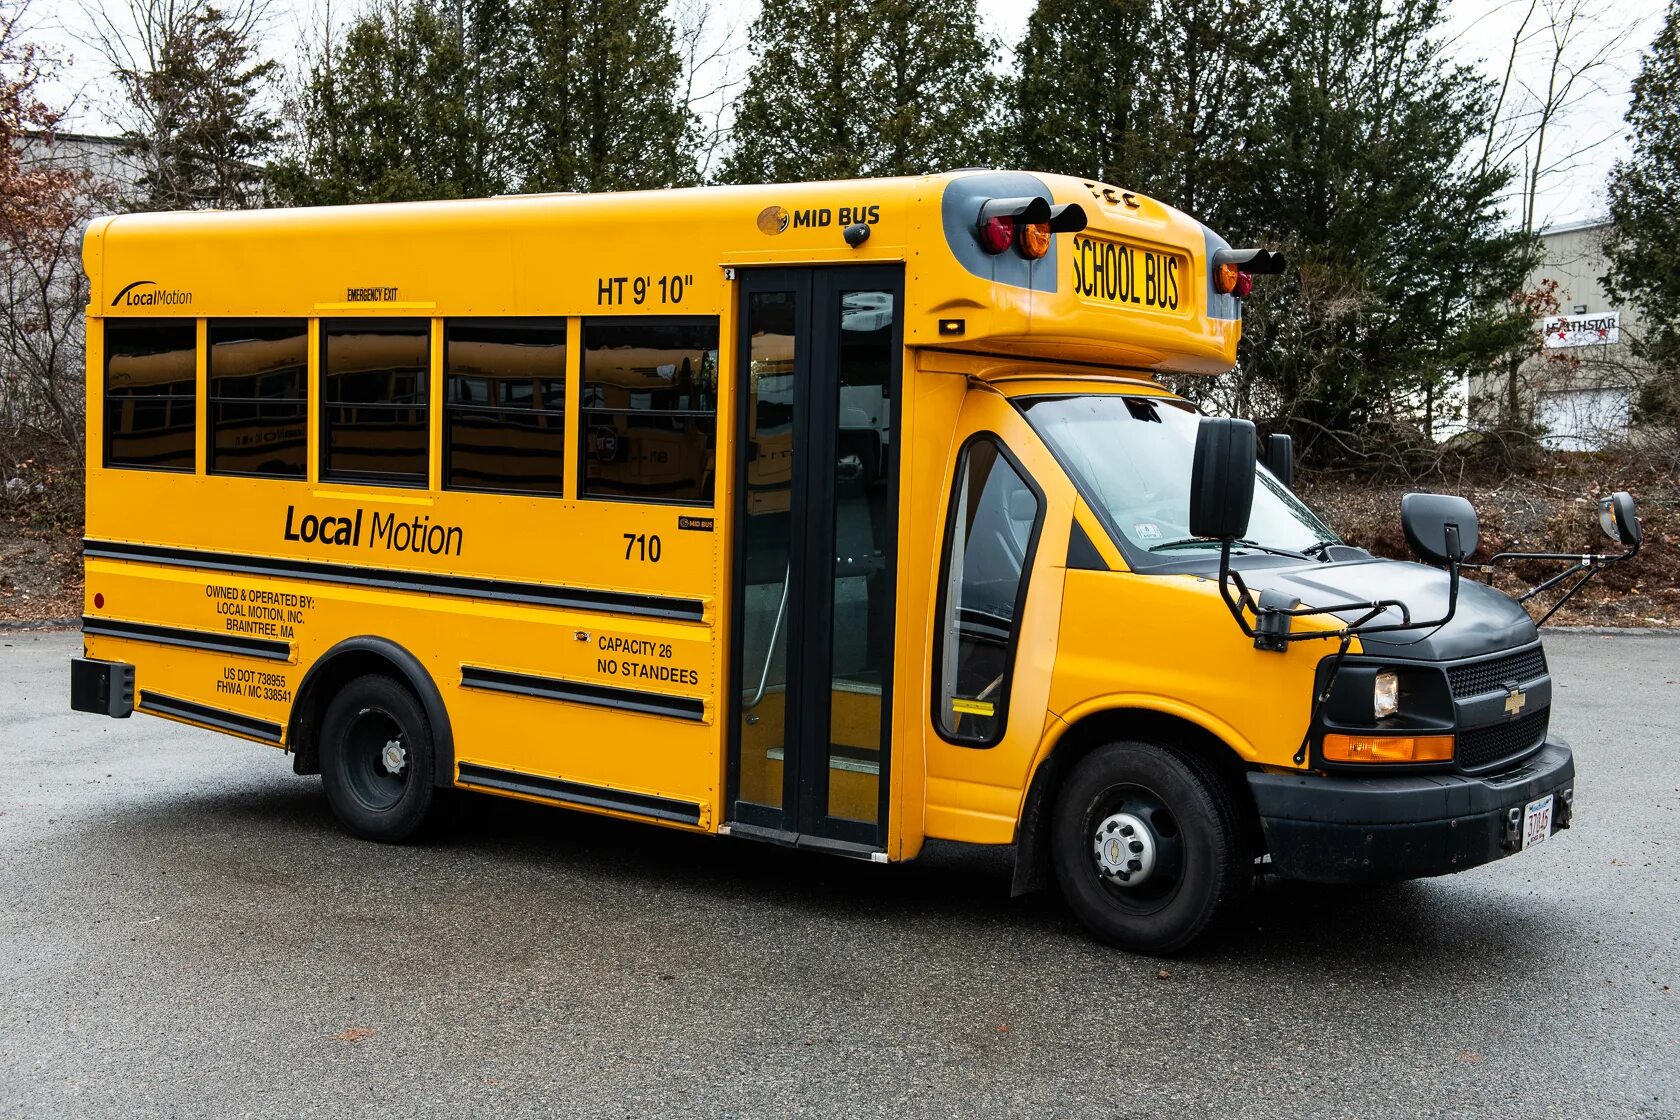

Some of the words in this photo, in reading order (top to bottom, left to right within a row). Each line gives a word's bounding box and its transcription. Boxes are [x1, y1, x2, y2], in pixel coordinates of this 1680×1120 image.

[794, 208, 831, 229] MID
[839, 205, 880, 226] BUS
[1073, 236, 1141, 304] SCHOOL
[1145, 252, 1179, 311] BUS
[347, 288, 382, 302] EMERGENCY
[383, 288, 398, 301] EXIT
[598, 277, 628, 305] HT
[633, 276, 650, 305] 9'
[658, 275, 693, 304] 10"
[1546, 318, 1616, 333] HELTHSTAR
[284, 505, 363, 546] Local
[369, 512, 463, 556] Motion
[623, 533, 662, 563] 710
[205, 585, 239, 600] OWNED
[240, 589, 247, 602] &
[248, 590, 298, 608] OPERATED
[300, 596, 315, 609] BY:
[217, 602, 247, 617] LOCAL
[248, 606, 285, 624] MOTION,
[288, 610, 305, 624] INC.
[226, 618, 278, 638] BRAINTREE,
[280, 625, 294, 639] MA
[598, 636, 656, 656] CAPACITY
[659, 644, 672, 659] 26
[224, 668, 235, 681] US
[238, 669, 255, 683] DOT
[257, 672, 286, 688] 738955
[597, 659, 618, 674] NO
[622, 662, 698, 685] STANDEES
[217, 680, 242, 695] FHWA
[249, 685, 262, 699] MC
[264, 689, 291, 703] 338541
